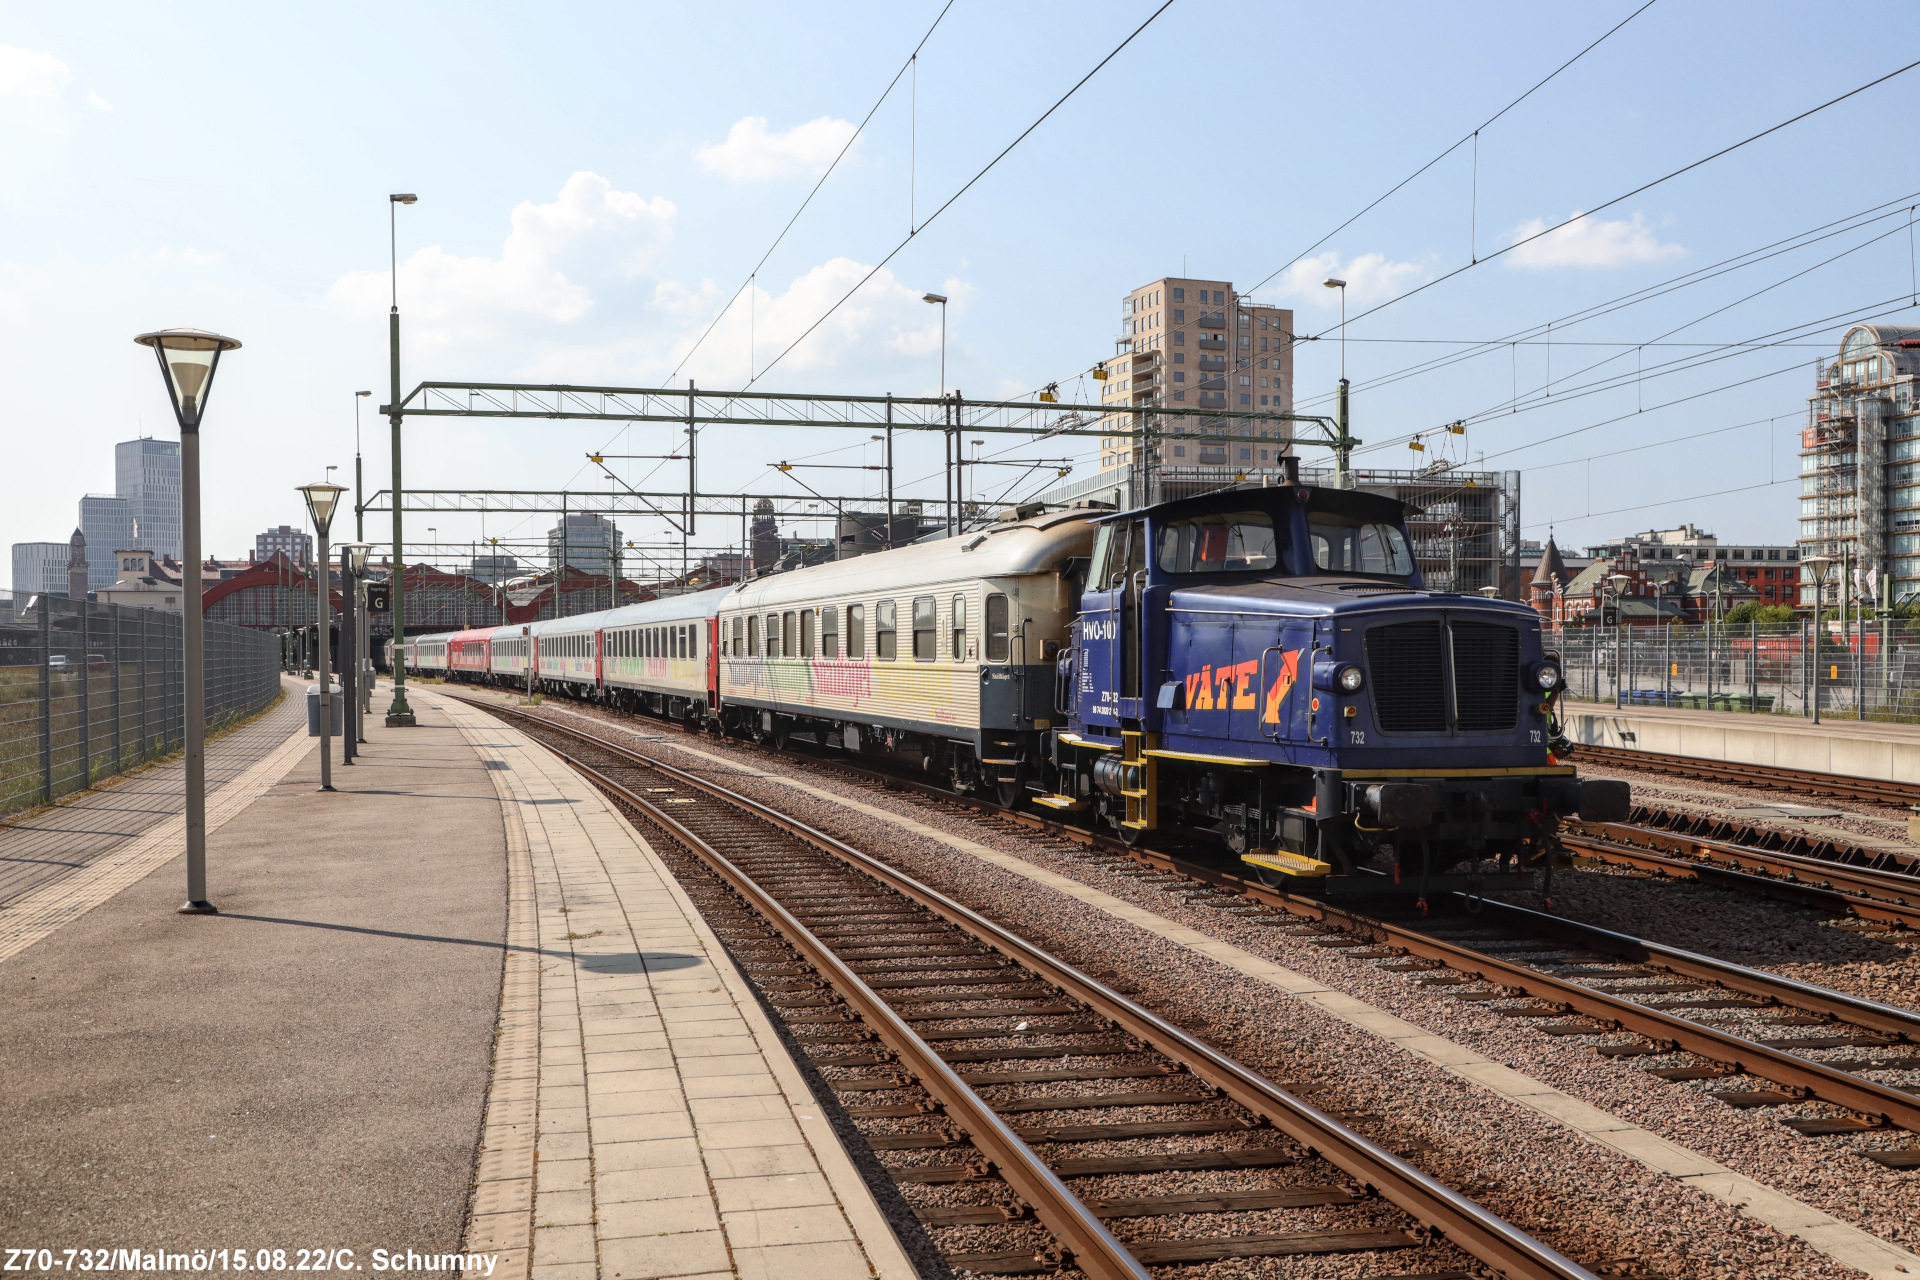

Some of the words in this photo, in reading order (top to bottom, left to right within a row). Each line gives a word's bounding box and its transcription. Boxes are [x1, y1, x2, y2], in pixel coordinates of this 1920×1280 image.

[375, 597, 383, 608] G
[1606, 615, 1613, 624] G
[1350, 731, 1365, 745] 732
[1529, 729, 1541, 744] 732
